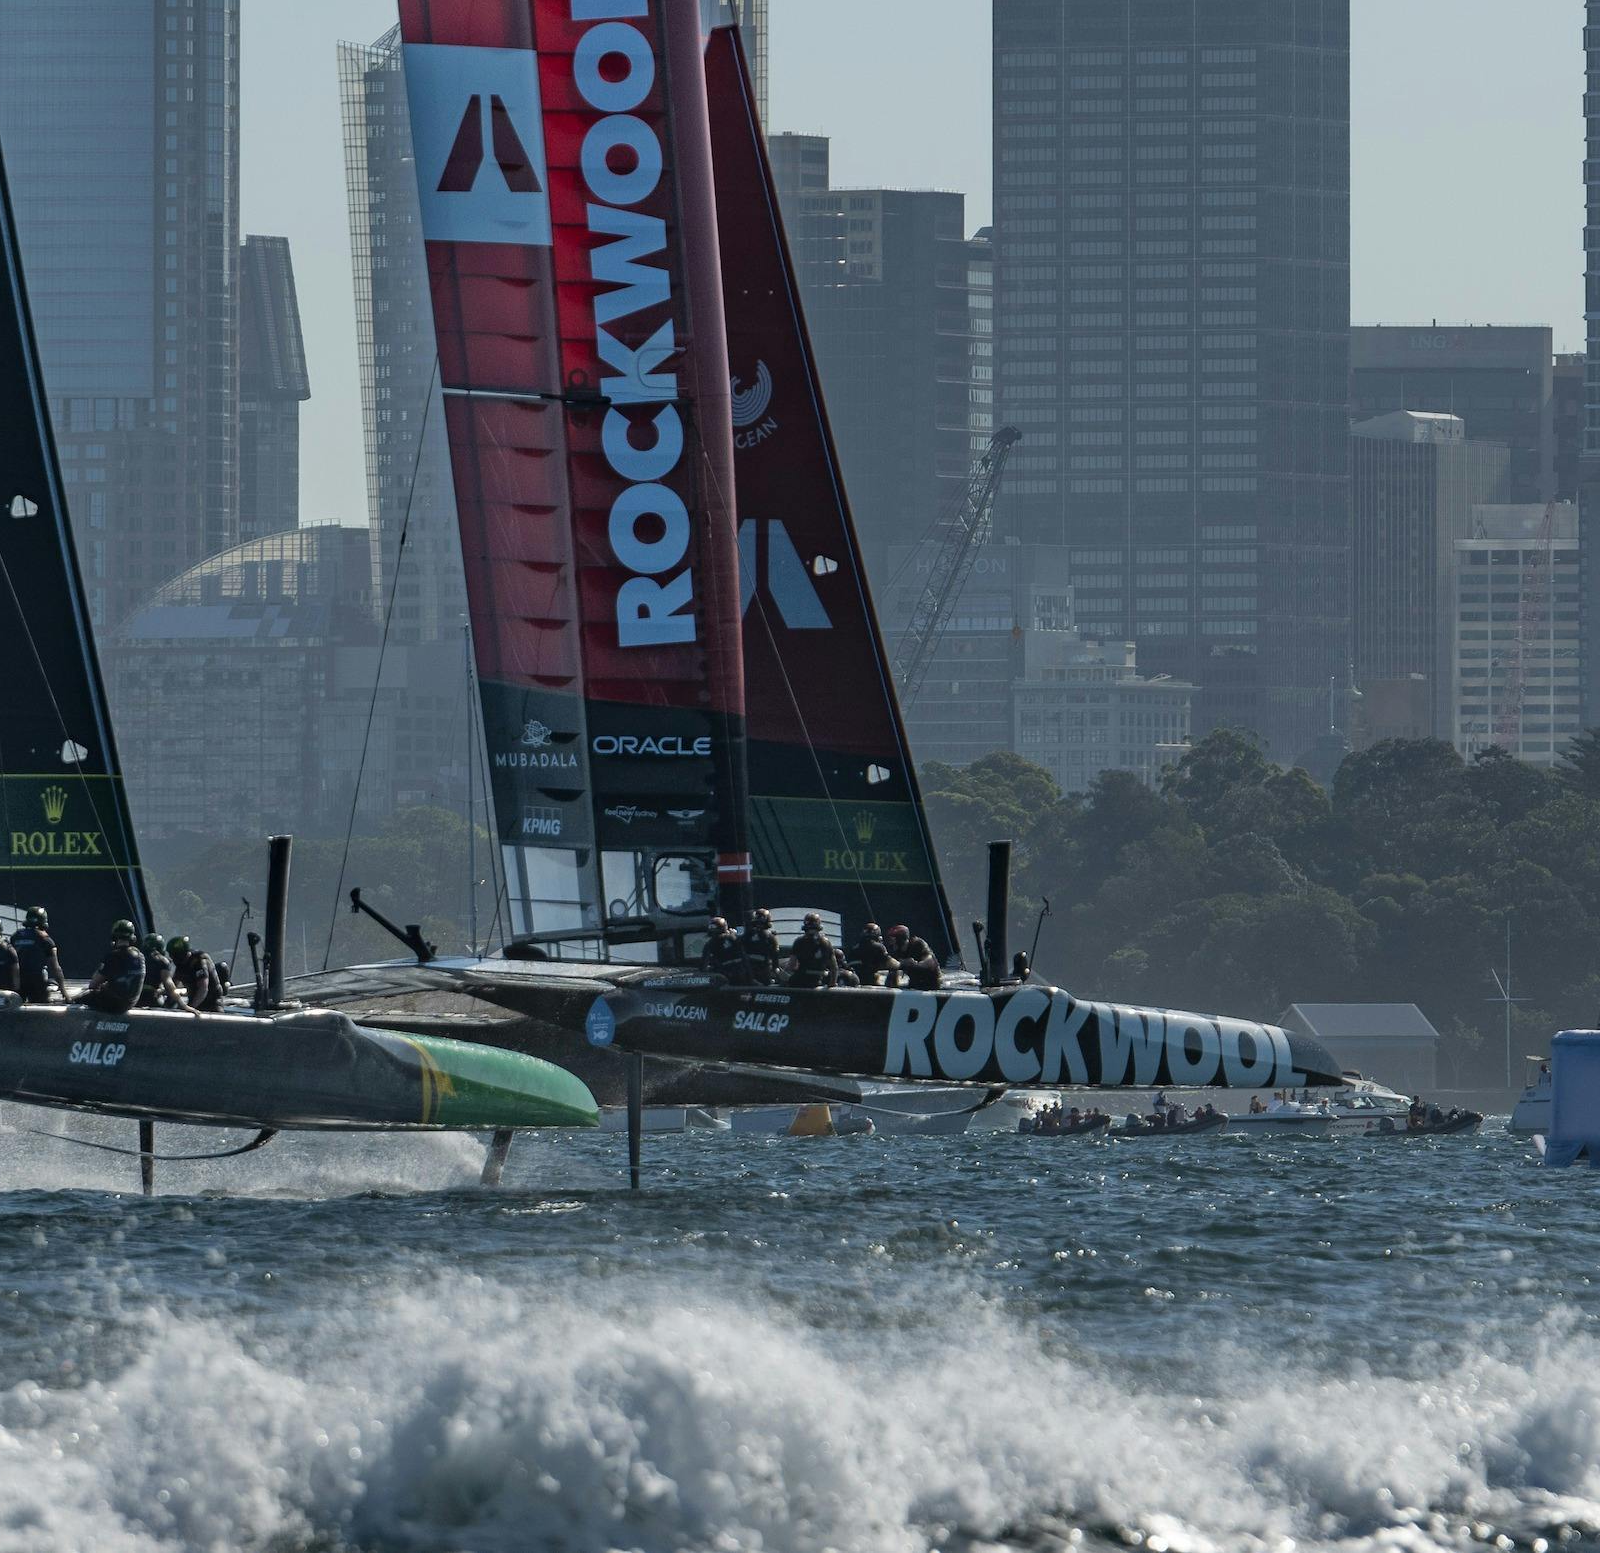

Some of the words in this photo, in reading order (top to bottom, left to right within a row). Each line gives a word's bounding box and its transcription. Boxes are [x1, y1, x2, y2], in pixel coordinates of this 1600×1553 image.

[1409, 335, 1447, 349] ING
[734, 416, 779, 450] CEAN
[593, 736, 711, 755] ORACLE
[496, 752, 578, 767] MUBADALA
[522, 817, 561, 835] KPMG
[11, 831, 102, 855] ROLEX
[824, 848, 909, 871] ROLEX
[675, 1005, 708, 1020] OCEAN
[884, 986, 1307, 1088] ROCKWOOL
